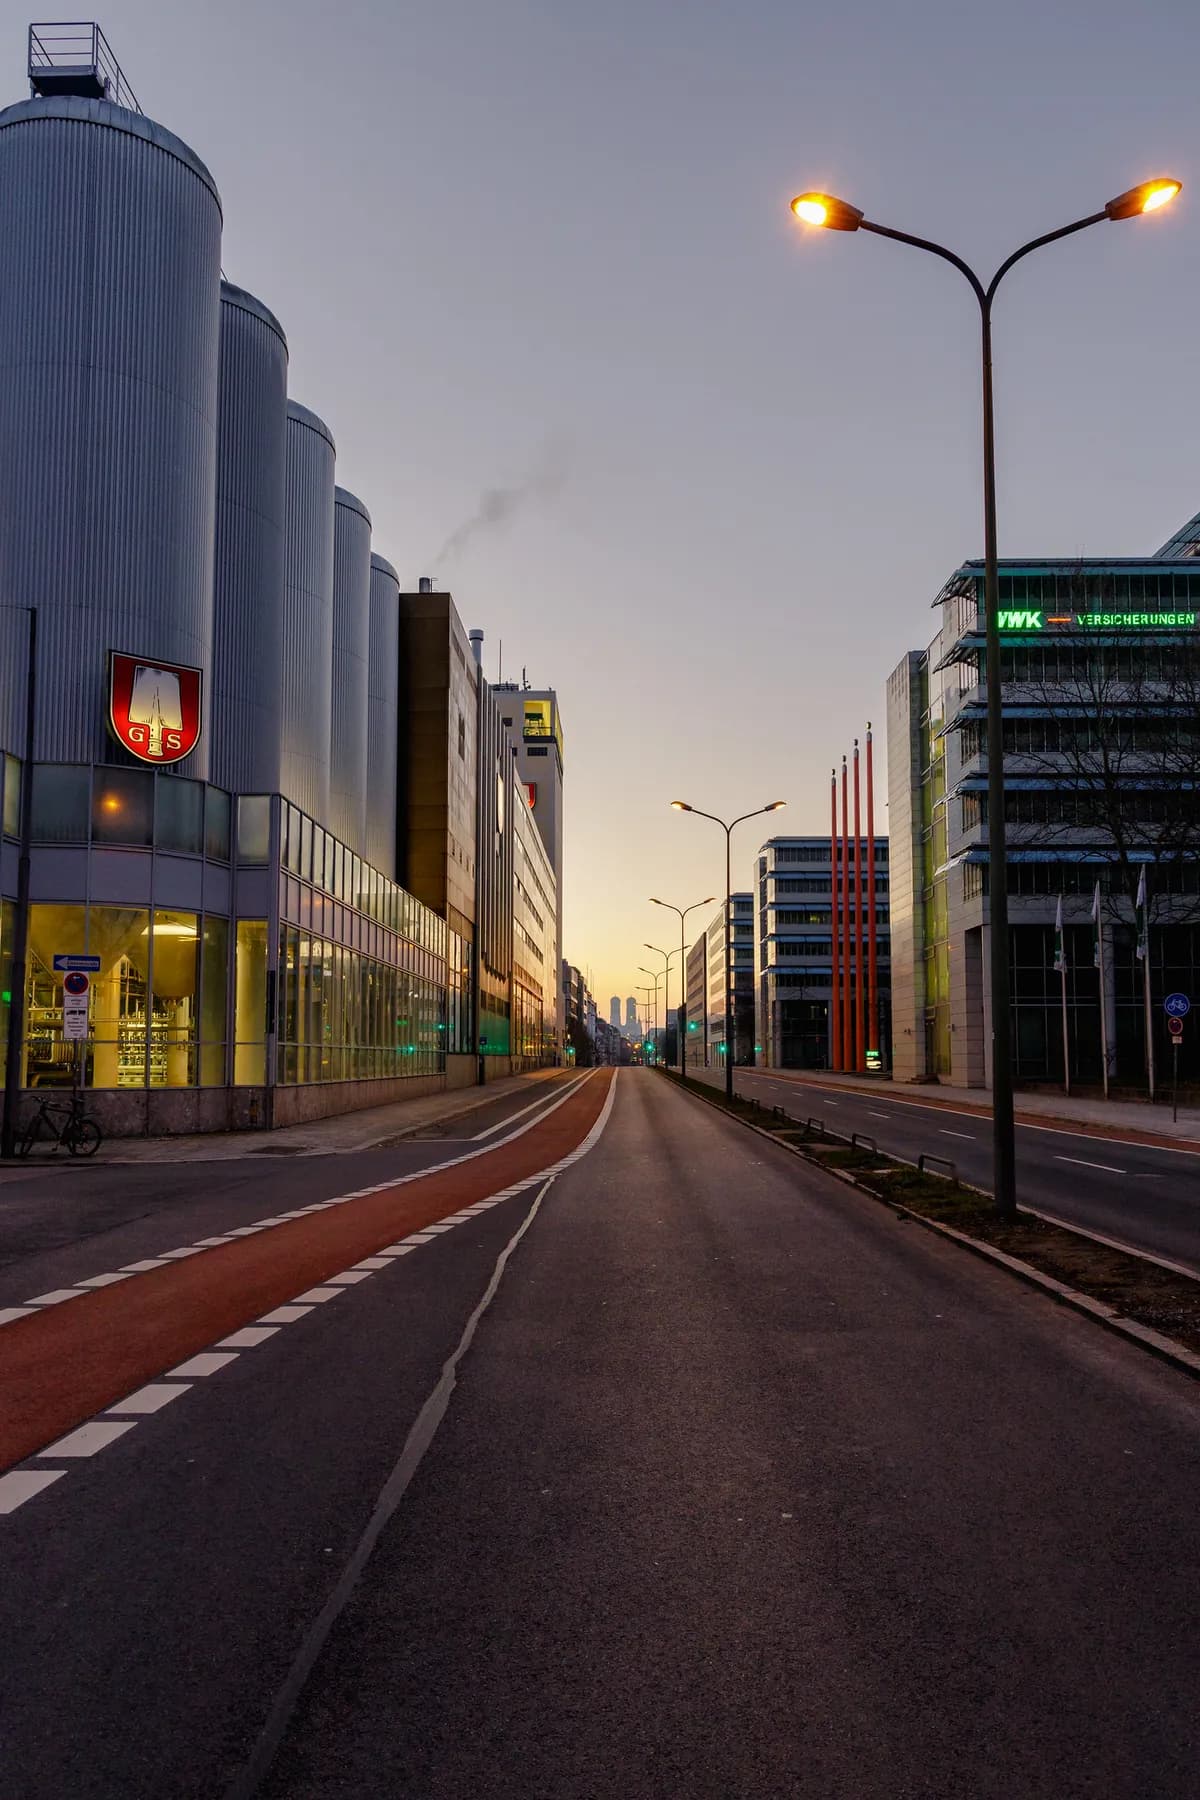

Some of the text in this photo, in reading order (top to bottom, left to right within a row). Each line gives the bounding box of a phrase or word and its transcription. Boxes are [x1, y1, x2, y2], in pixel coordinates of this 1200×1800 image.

[1077, 613, 1195, 626] VERSICHERUNGEN
[128, 727, 182, 750] G S
